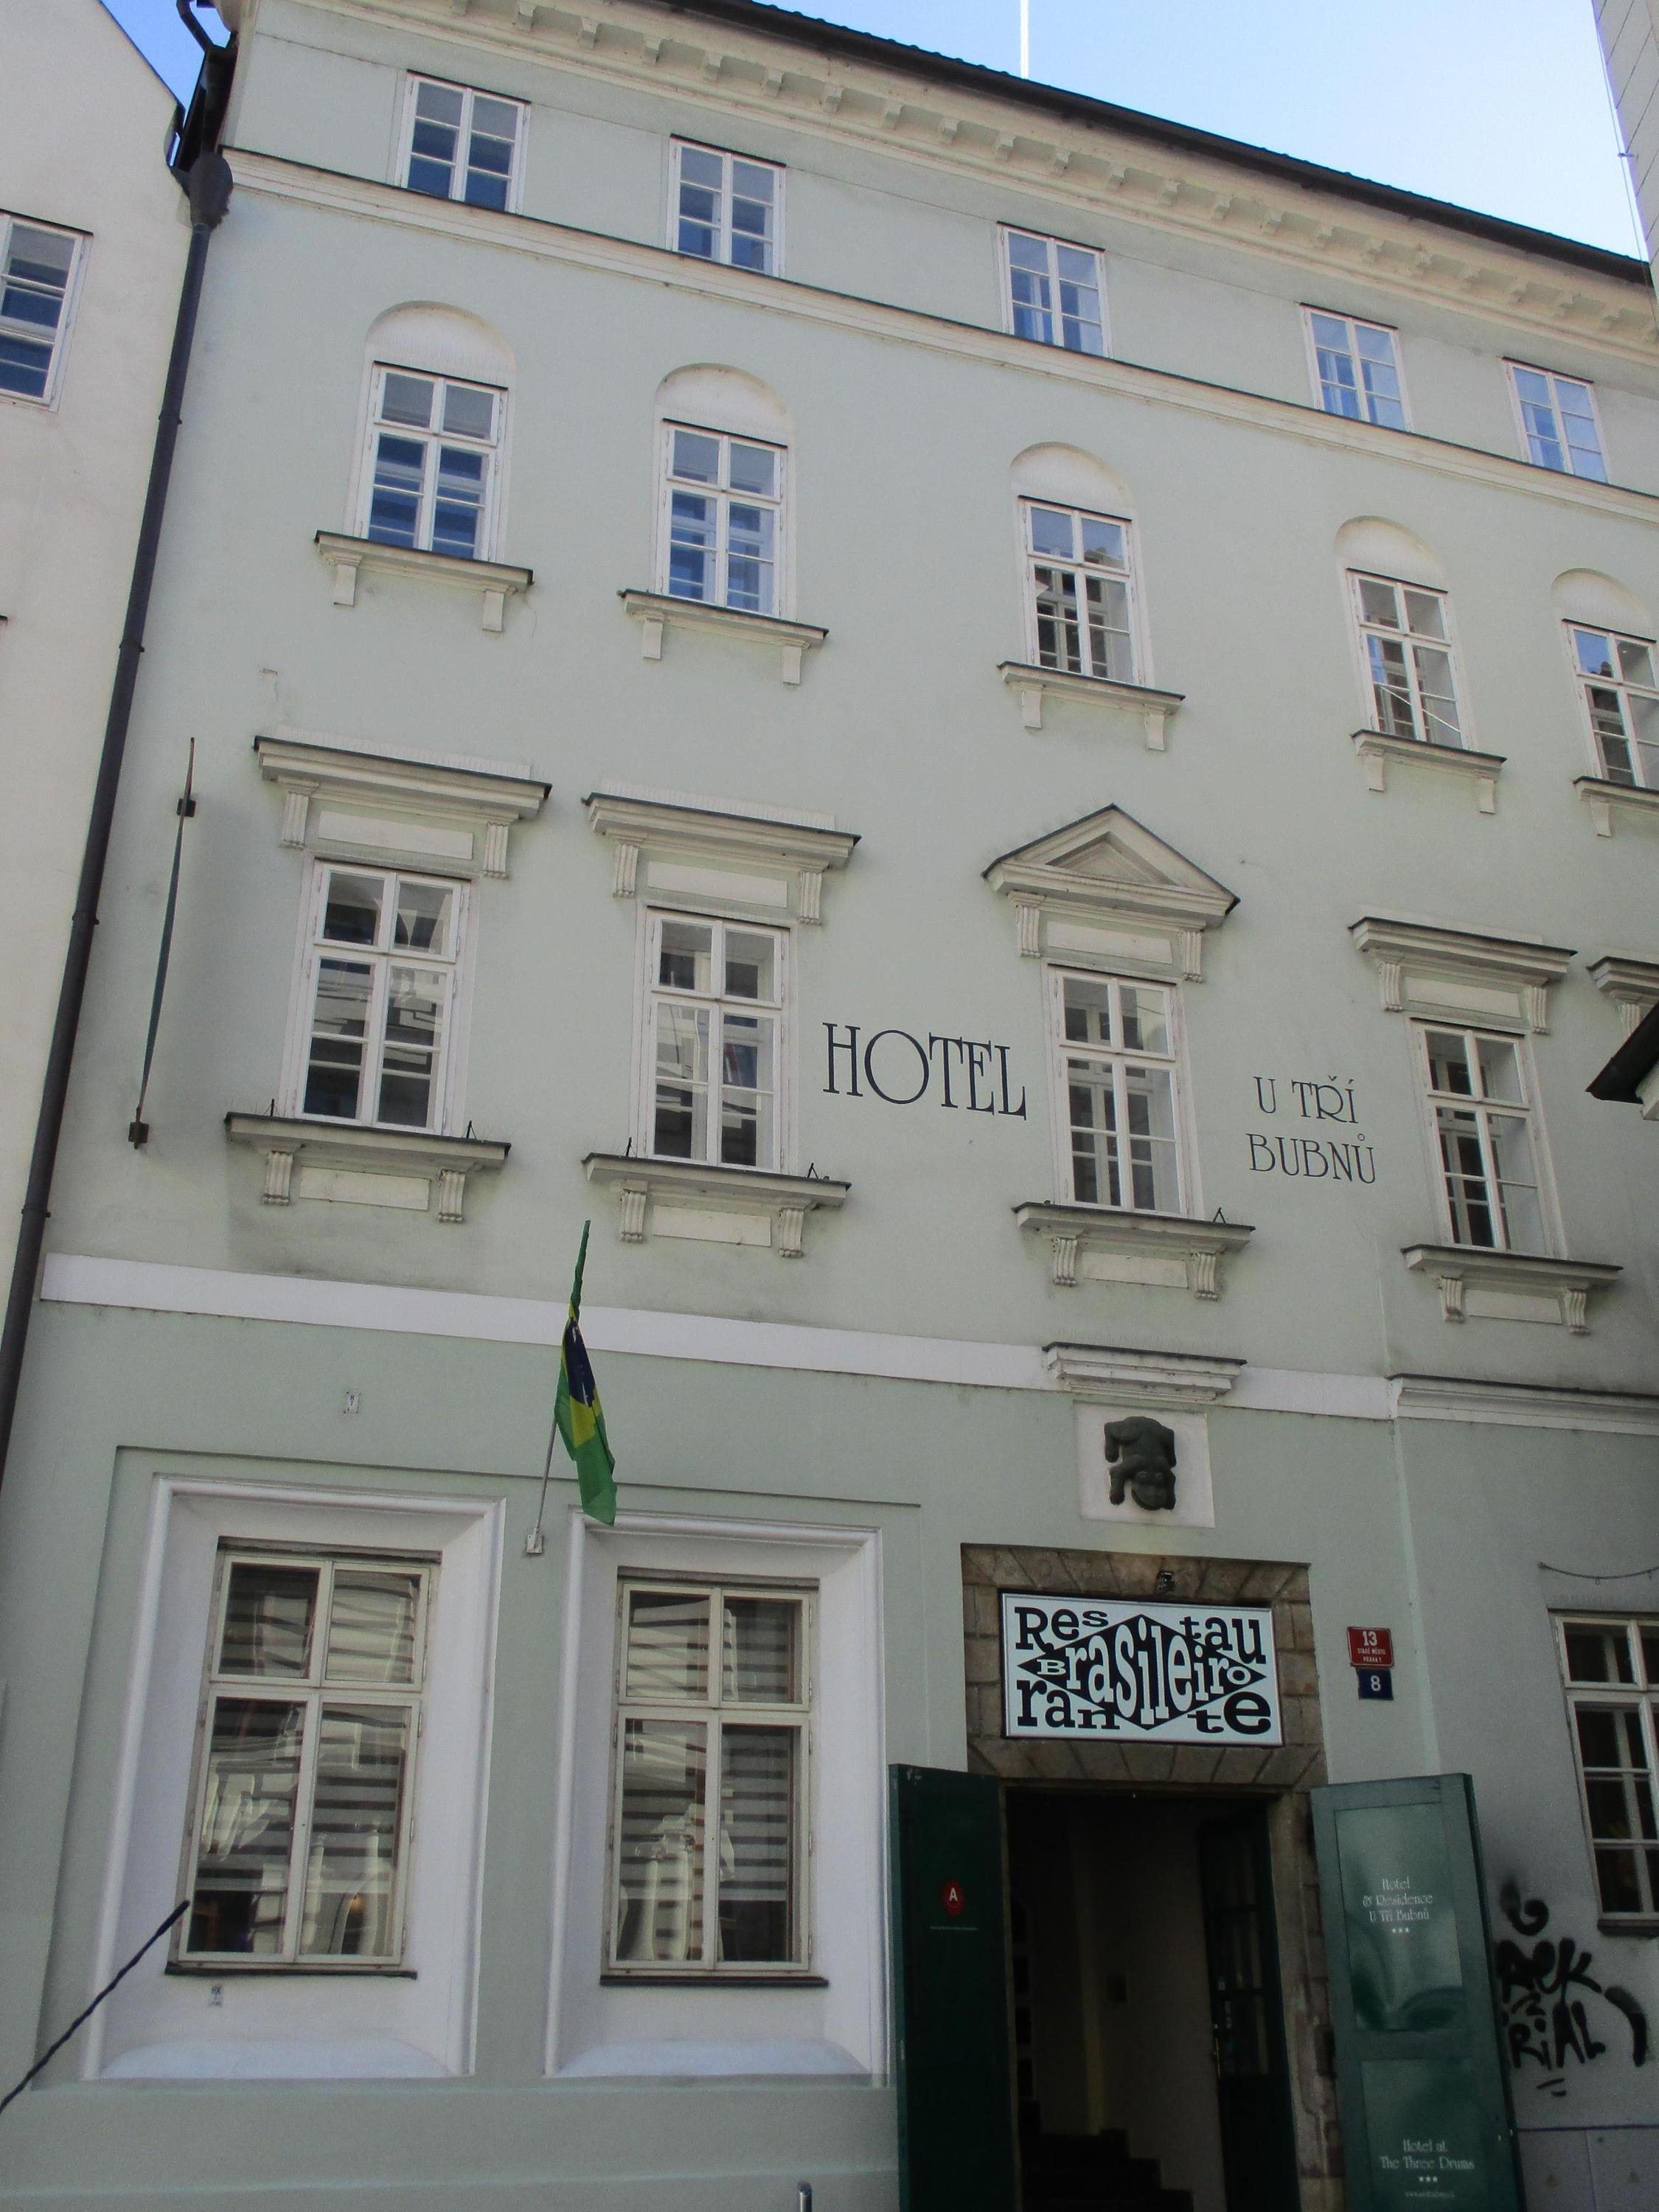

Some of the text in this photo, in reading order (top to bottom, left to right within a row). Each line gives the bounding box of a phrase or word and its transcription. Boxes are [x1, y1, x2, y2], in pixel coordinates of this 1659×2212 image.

[822, 1022, 1026, 1121] HOTEL
[1253, 1075, 1359, 1124] U TŘÍ
[1245, 1133, 1376, 1184] BUBNŮ
[1363, 1630, 1377, 1646] 13
[1036, 1616, 1252, 1726] Brasileiro
[1370, 1675, 1381, 1691] 8
[1382, 1877, 1410, 1891] Hotel
[949, 1887, 958, 1902] A
[1376, 1893, 1433, 1906] Residence
[1403, 2139, 1433, 2152] Hotel
[1380, 2154, 1475, 2170] The Three Drums
